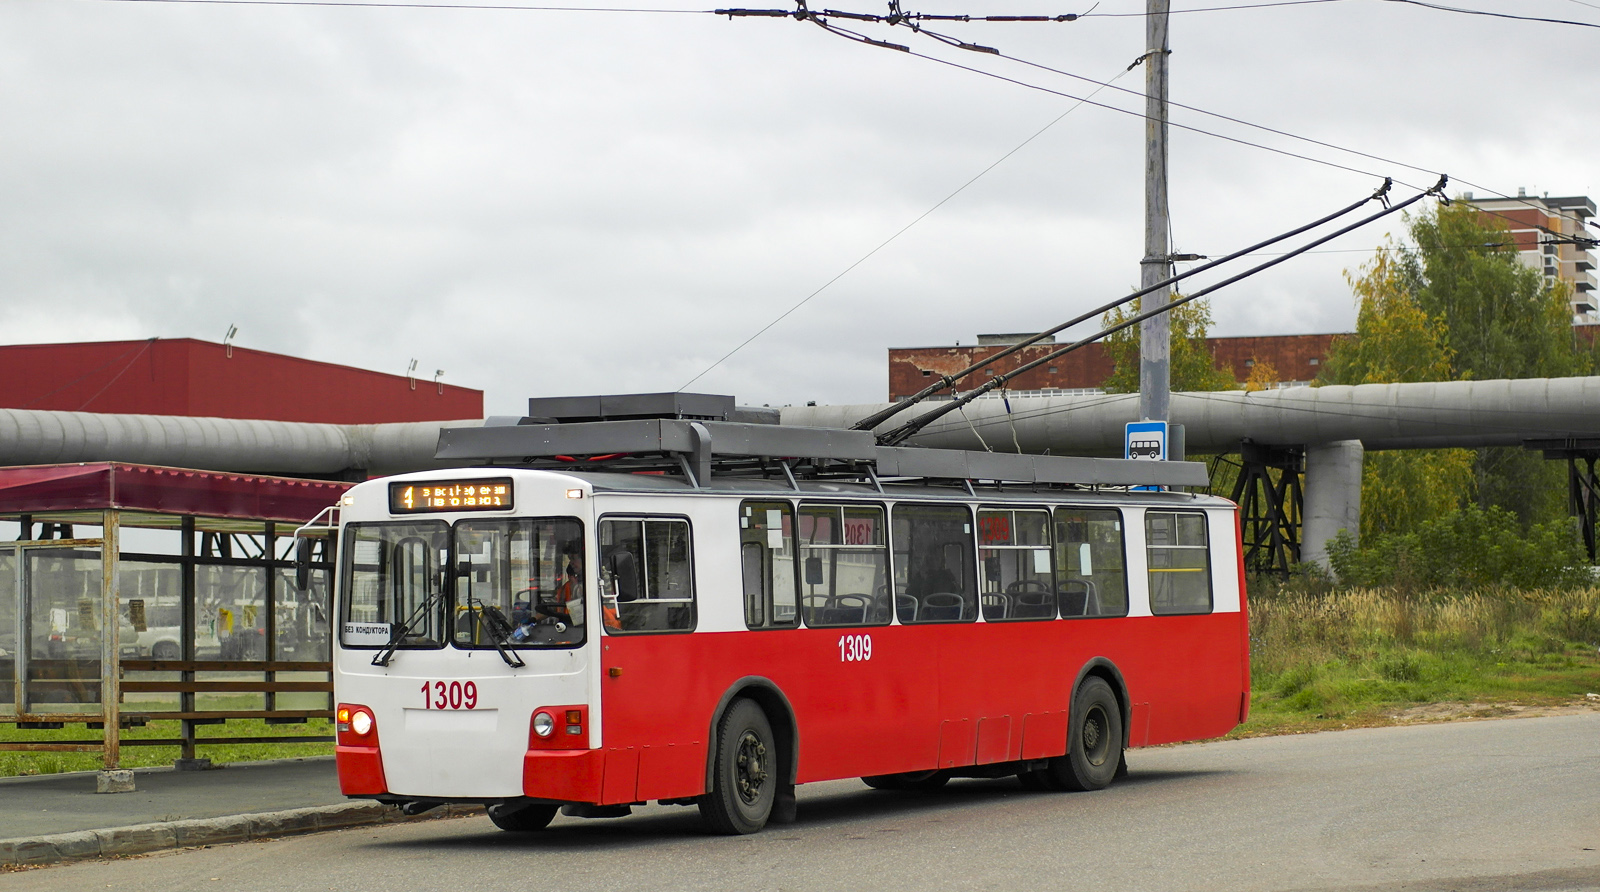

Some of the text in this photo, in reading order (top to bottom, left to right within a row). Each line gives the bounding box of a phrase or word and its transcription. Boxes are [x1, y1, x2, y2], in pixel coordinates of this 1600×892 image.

[979, 517, 1009, 541] 1309
[838, 634, 872, 662] 1309
[421, 681, 477, 709] 1309
